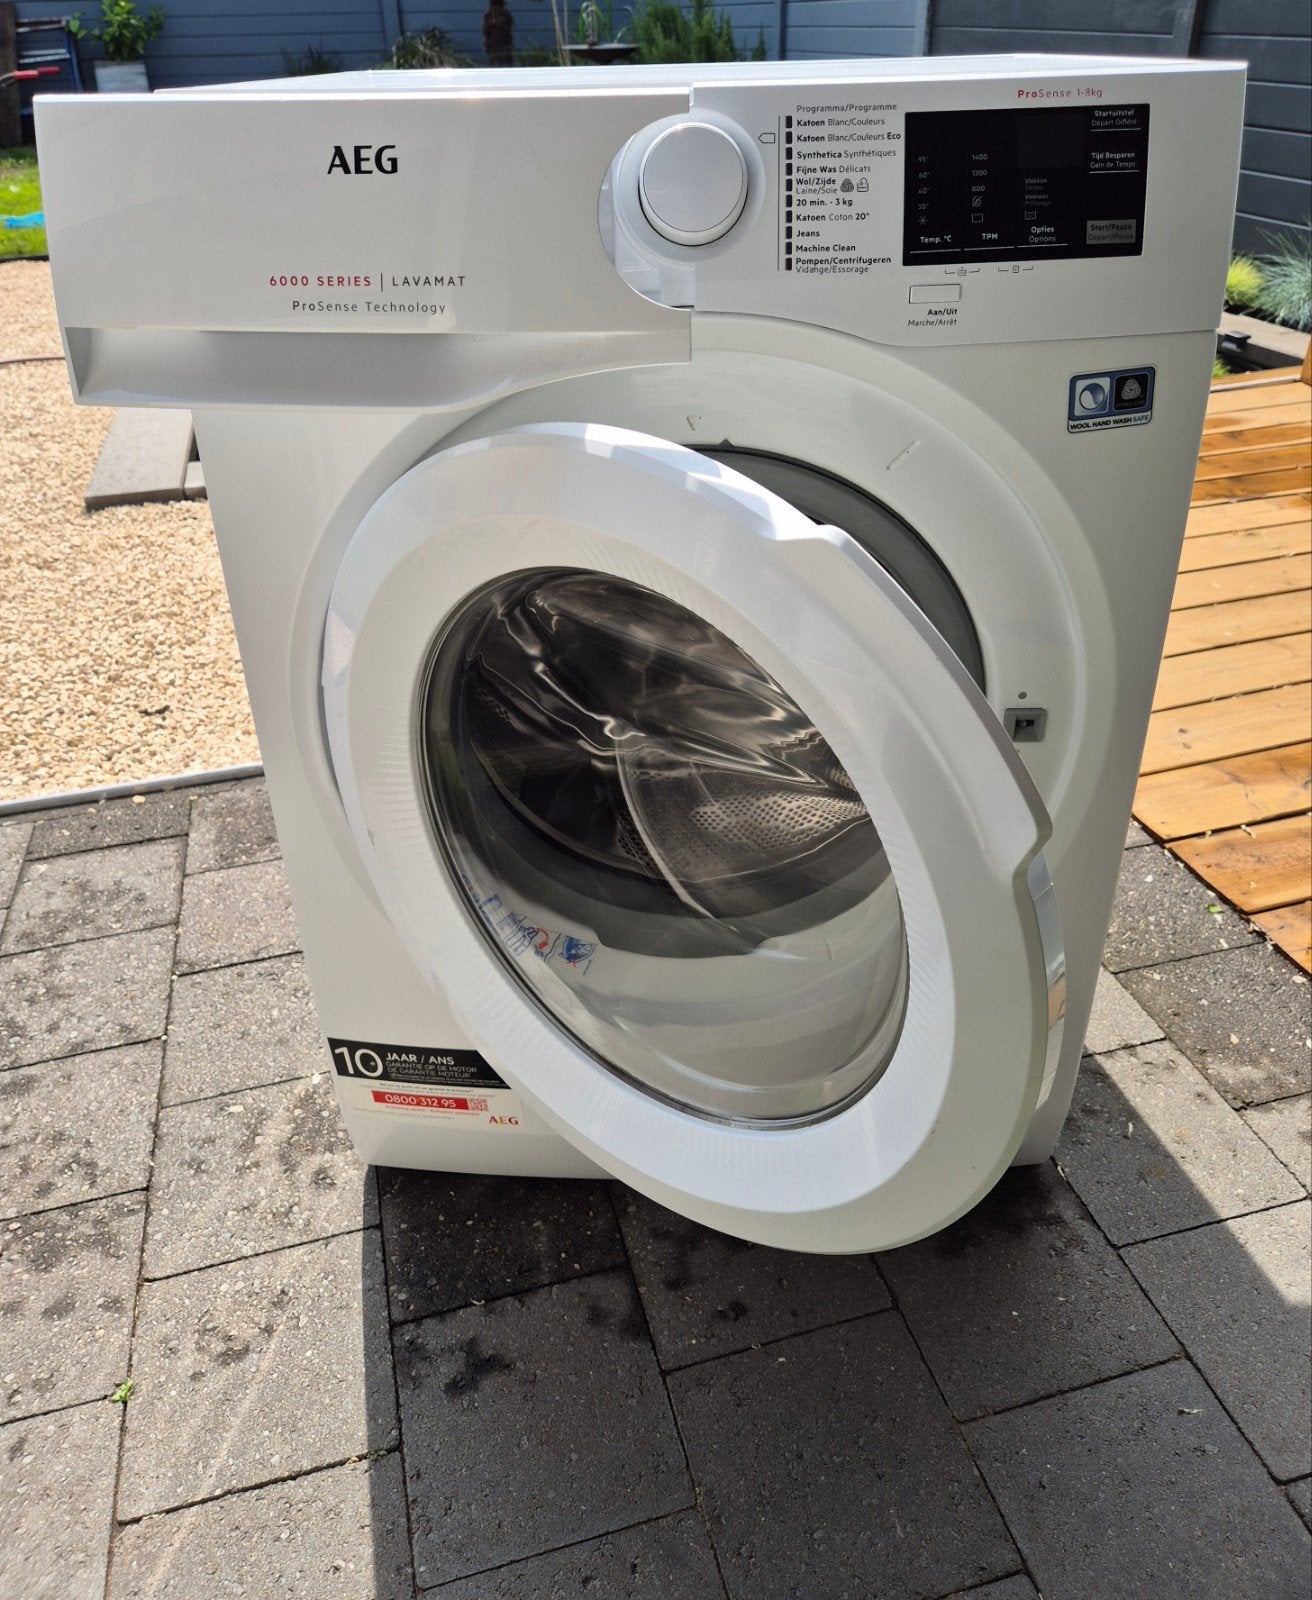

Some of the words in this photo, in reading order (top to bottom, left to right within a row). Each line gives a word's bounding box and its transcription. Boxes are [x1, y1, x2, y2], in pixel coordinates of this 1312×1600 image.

[1018, 89, 1072, 98] ProSense
[1076, 88, 1103, 99] 1-8kg
[796, 104, 898, 114] Programma/Programme
[1094, 109, 1134, 118] Startuitstel
[828, 117, 886, 127] Blanc/Couleurs
[828, 133, 885, 142] Blanc/Couleurs
[887, 132, 902, 140] Eco
[327, 144, 398, 174] AEG
[797, 150, 842, 161] Synthetica
[844, 149, 896, 160] Synthétiques
[1091, 152, 1104, 160] Tijd
[1105, 151, 1136, 160] Besparen
[1090, 161, 1105, 169] Gain
[1116, 160, 1136, 168] Temps
[796, 166, 817, 176] Fijne
[839, 164, 872, 173] Délicats
[796, 177, 837, 188] Wol/Zijde
[796, 186, 838, 195] Laine/Soie
[796, 198, 807, 207] 20
[810, 198, 828, 206] min.
[835, 198, 840, 206] 3
[843, 198, 853, 207] kg
[796, 214, 826, 222] Katoen
[829, 213, 853, 221] Coton
[855, 212, 870, 220] 20°
[1031, 225, 1055, 234] Opties
[1090, 222, 1133, 232] Start/Pauze
[796, 230, 820, 238] Jeans
[1029, 234, 1056, 243] Options
[1088, 231, 1134, 241] Départ/Pause
[920, 236, 942, 244] Temp.
[796, 244, 831, 252] Machine
[832, 244, 856, 252] Clean
[796, 256, 892, 266] Pompen/Centrifugeren
[796, 265, 869, 275] Vidange/Essorage
[269, 275, 310, 287] 6000
[317, 276, 372, 287] SERIES
[392, 276, 466, 287] LAVAMAT
[292, 300, 358, 312] ProSense
[366, 301, 446, 315] Technology
[928, 308, 958, 316] Aan/Uit
[908, 318, 958, 327] Marche/Arrêt
[1092, 420, 1112, 428] HAND
[1132, 414, 1150, 422] SAFE
[334, 1046, 384, 1077] 10
[385, 1052, 418, 1063] JAAR
[429, 1056, 455, 1066] ANS
[385, 1061, 425, 1070] GARANTIE
[387, 1066, 398, 1074] DE
[400, 1068, 437, 1076] GARANTIE
[384, 1094, 417, 1105] 0800
[420, 1096, 438, 1108] 312
[441, 1097, 457, 1108] 95
[489, 1115, 519, 1126] AEG
